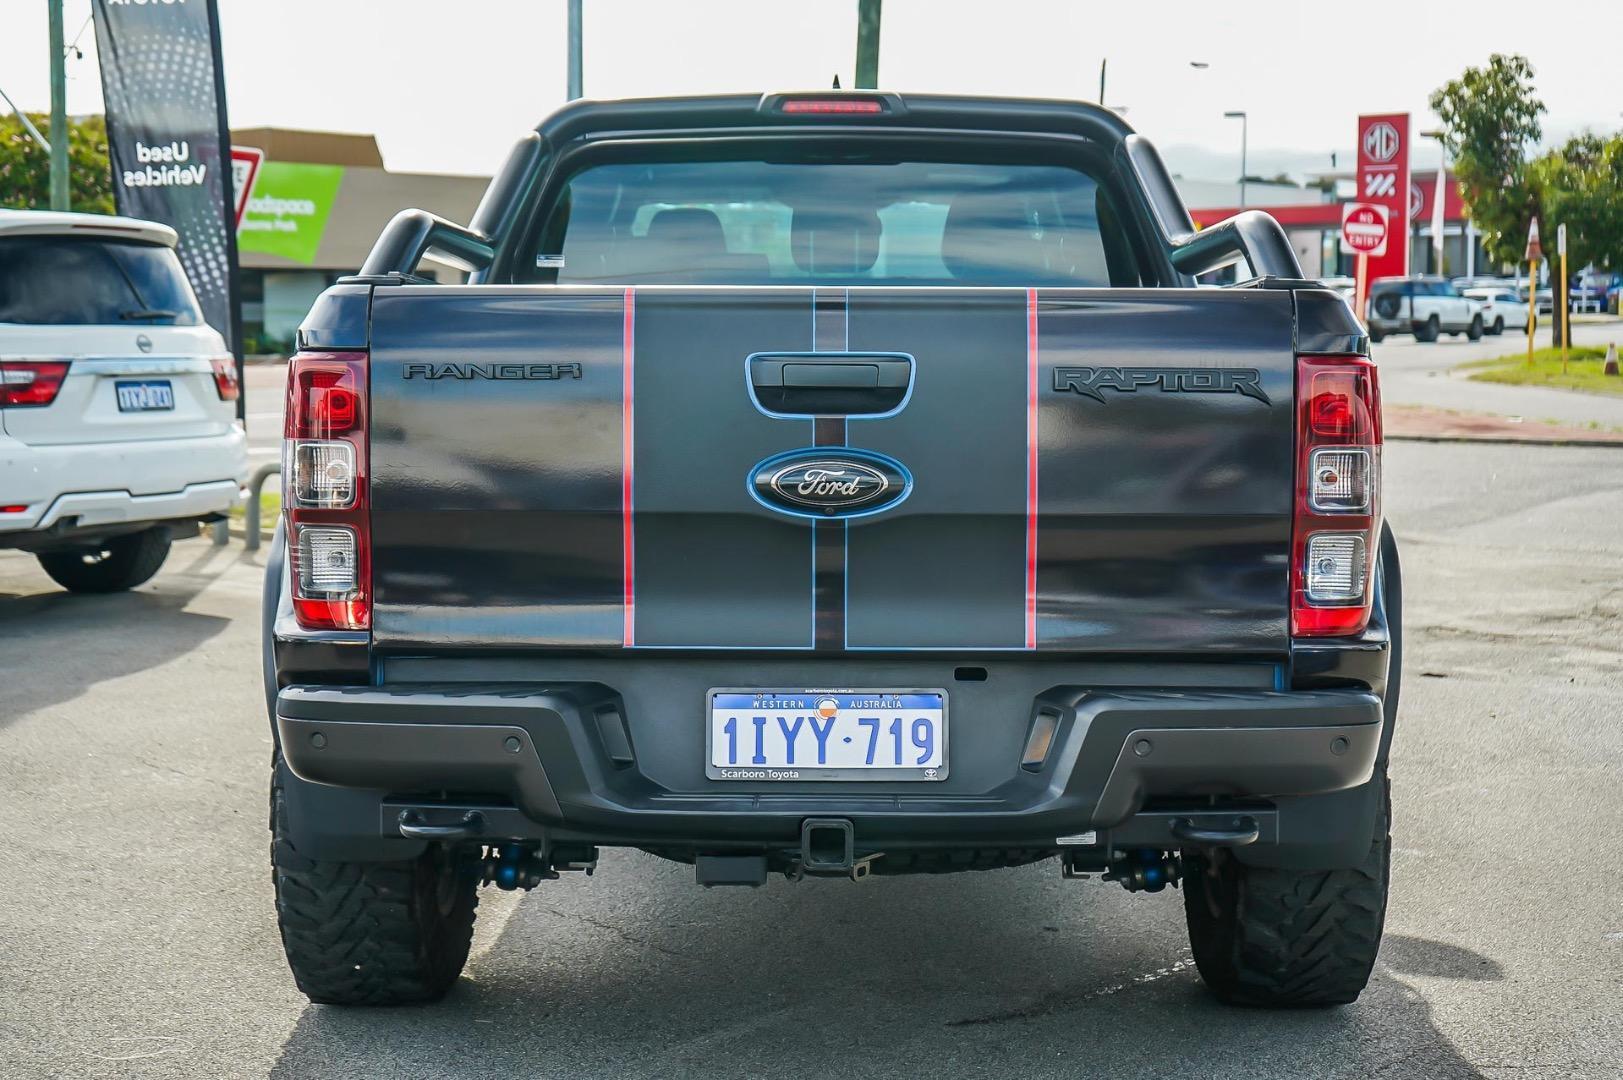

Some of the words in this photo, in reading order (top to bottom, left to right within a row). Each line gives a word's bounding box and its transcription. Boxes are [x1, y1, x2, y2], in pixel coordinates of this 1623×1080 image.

[1366, 123, 1398, 162] MG
[1359, 211, 1374, 224] NO
[1350, 235, 1380, 247] ENTRY
[402, 362, 582, 380] RANGER
[1053, 366, 1272, 407] RAPTOR
[798, 469, 861, 495] Ford
[752, 700, 805, 709] WESTERN
[850, 700, 903, 709] AUSTRALIA
[721, 769, 765, 779] Scarboro
[768, 769, 799, 779] Toyota
